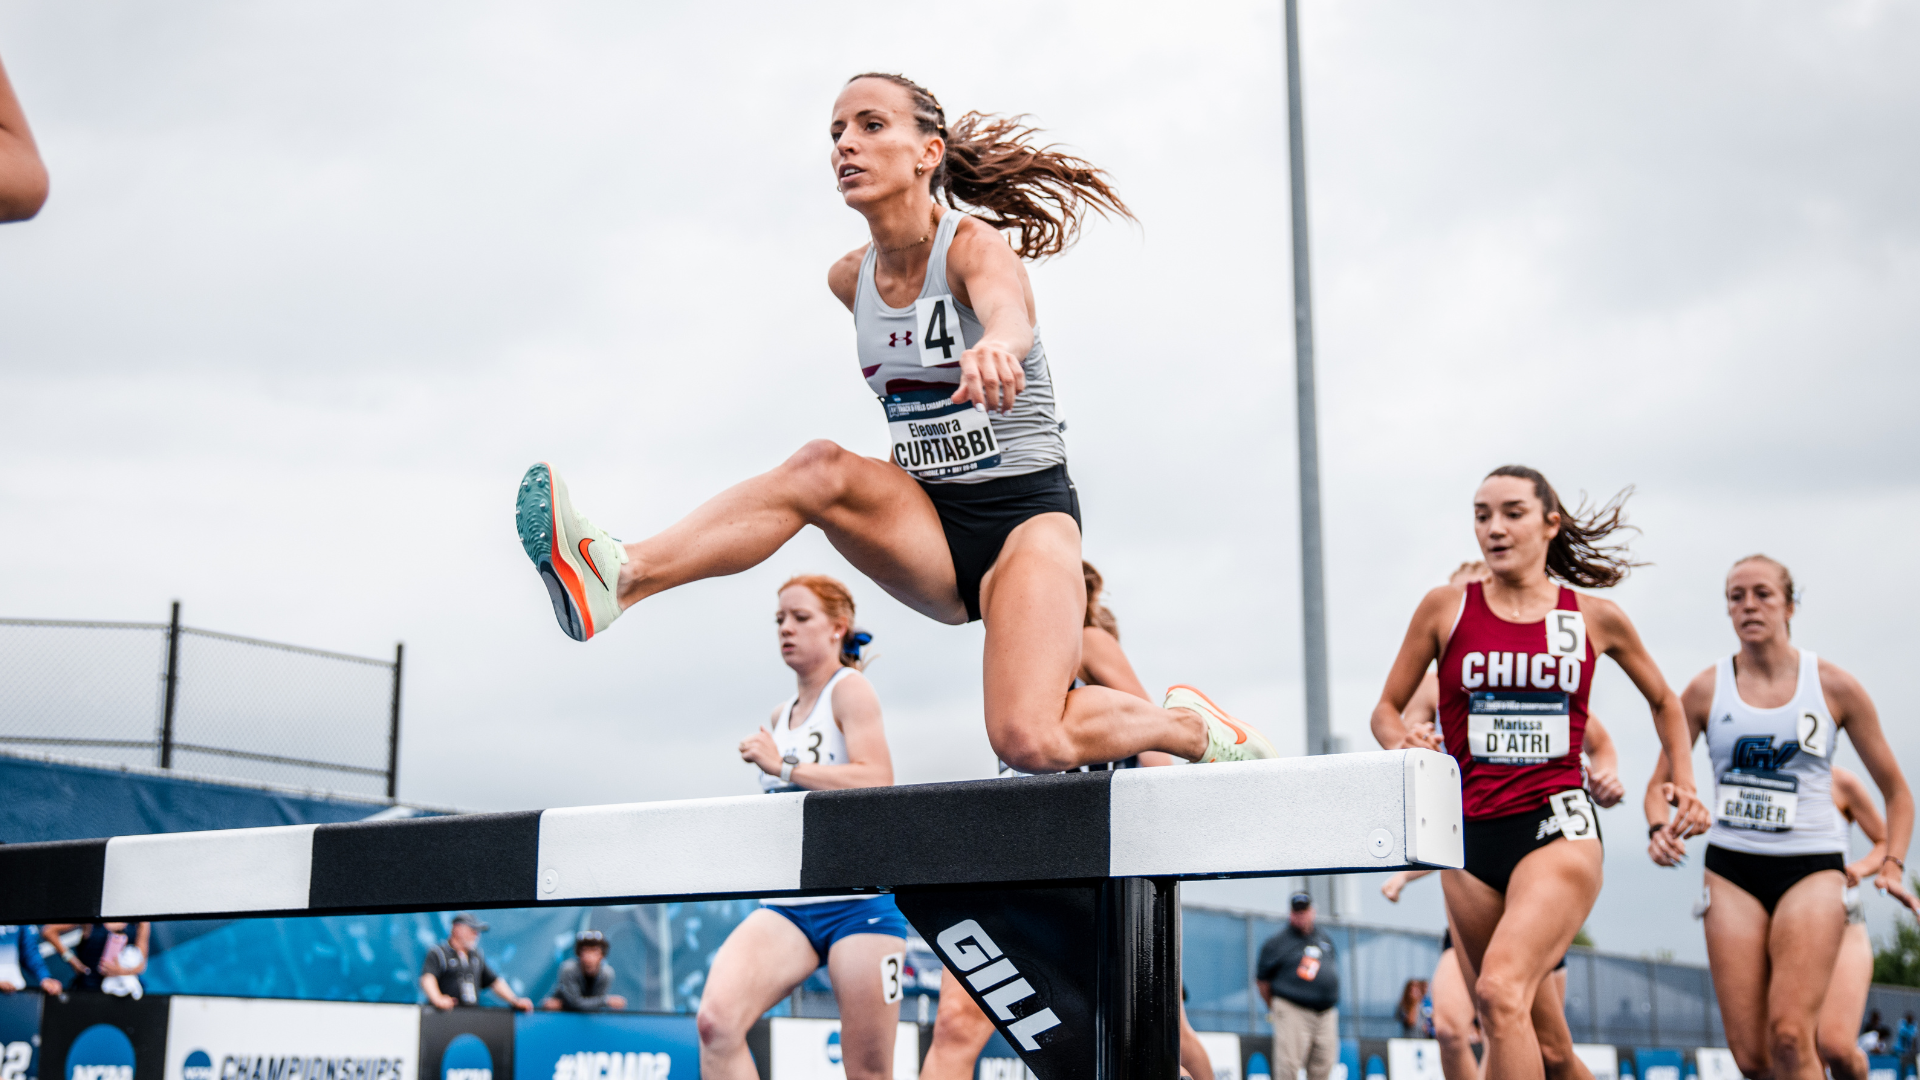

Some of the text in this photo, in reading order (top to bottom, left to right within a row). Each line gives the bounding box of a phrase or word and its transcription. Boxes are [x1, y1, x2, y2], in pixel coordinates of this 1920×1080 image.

[925, 300, 955, 359] 4
[894, 426, 996, 467] CURTABBI
[908, 419, 962, 438] Eleonora
[1557, 614, 1577, 653] 5
[1461, 652, 1581, 693] CHICO
[1493, 718, 1542, 730] Marissa
[1803, 714, 1818, 749] 2
[808, 731, 823, 763] 3
[1486, 733, 1549, 753] D'ATRI
[1562, 795, 1588, 836] 5
[1724, 800, 1787, 824] GRABER
[888, 958, 899, 1000] 3
[936, 919, 1062, 1052] GILL
[220, 1055, 403, 1080] CHAMPIONSHIPS
